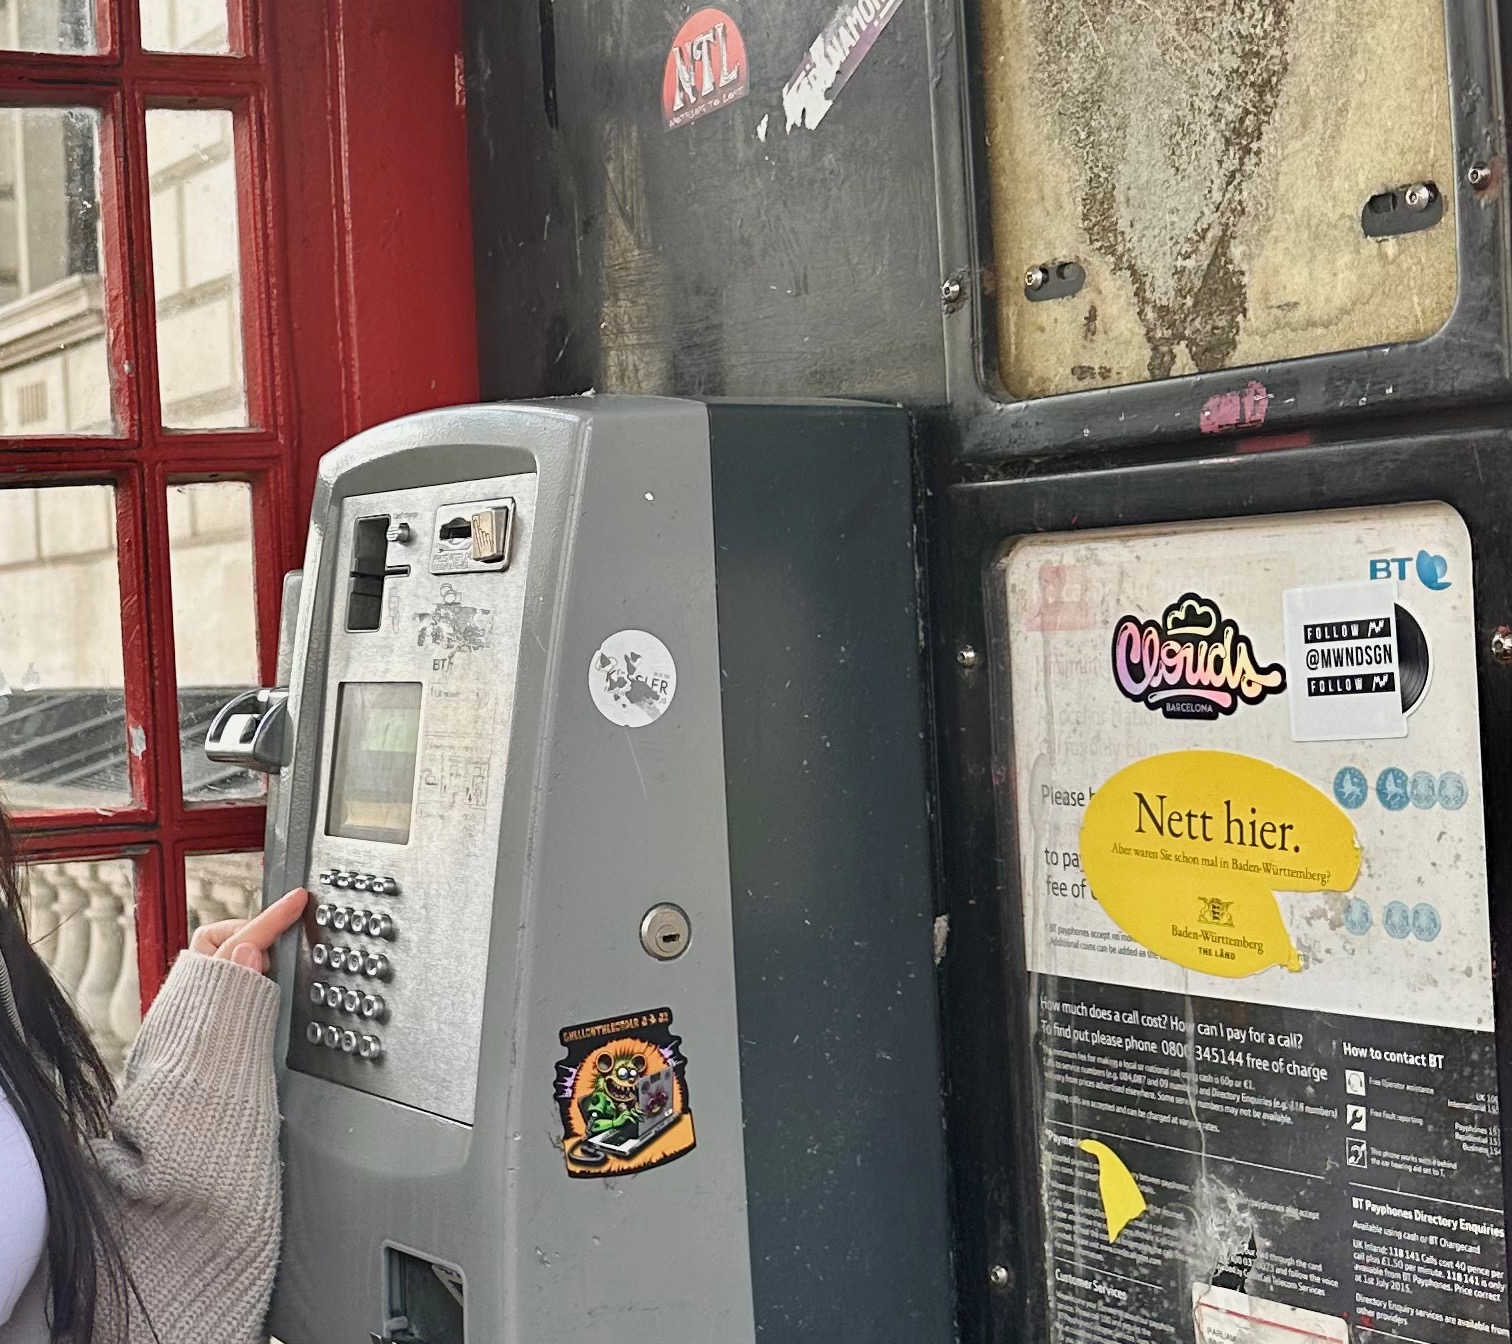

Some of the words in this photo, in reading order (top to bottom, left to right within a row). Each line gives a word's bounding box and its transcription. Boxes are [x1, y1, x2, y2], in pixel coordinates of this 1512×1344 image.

[1369, 557, 1413, 581] BT
[1307, 623, 1359, 641] FOLLOW
[1116, 620, 1283, 699] Clouds
[1306, 644, 1392, 670] @MWNDSGN
[1310, 677, 1363, 694] FOLLOW
[1165, 701, 1214, 715] BARCELONA
[1041, 784, 1085, 807] Please
[1133, 791, 1213, 842] Nett
[1224, 800, 1300, 853] hier.
[1044, 848, 1059, 865] to
[1111, 842, 1132, 856] Aber
[1174, 852, 1199, 866] schon
[1201, 855, 1218, 867] mal
[1046, 875, 1068, 897] fee
[1071, 877, 1087, 899] of
[1040, 997, 1061, 1013] How
[1062, 1002, 1088, 1017] much
[1089, 1004, 1112, 1022] does
[1113, 1010, 1120, 1021] a
[1122, 1009, 1139, 1025] call
[1141, 1014, 1167, 1030] cost?
[1197, 1022, 1218, 1036] can
[1226, 1026, 1247, 1044] pay
[1248, 1027, 1265, 1044] for
[1268, 1033, 1275, 1045] a
[1277, 1032, 1304, 1050] call?
[1053, 1023, 1071, 1040] find
[1073, 1028, 1090, 1043] out
[1091, 1030, 1123, 1048] please
[1125, 1035, 1157, 1054] phone
[1195, 1044, 1244, 1067] 345144
[1246, 1051, 1270, 1068] free
[1272, 1057, 1286, 1074] of
[1287, 1060, 1328, 1082] charge
[1342, 1041, 1368, 1059] How
[1369, 1046, 1382, 1061] to
[1384, 1050, 1427, 1068] contact
[1428, 1053, 1445, 1069] BT
[1352, 1197, 1364, 1209] BT
[1365, 1199, 1413, 1221] Payphones
[1414, 1209, 1458, 1231] Directory
[1459, 1218, 1505, 1238] Enquiries
[1455, 1260, 1466, 1271] 40
